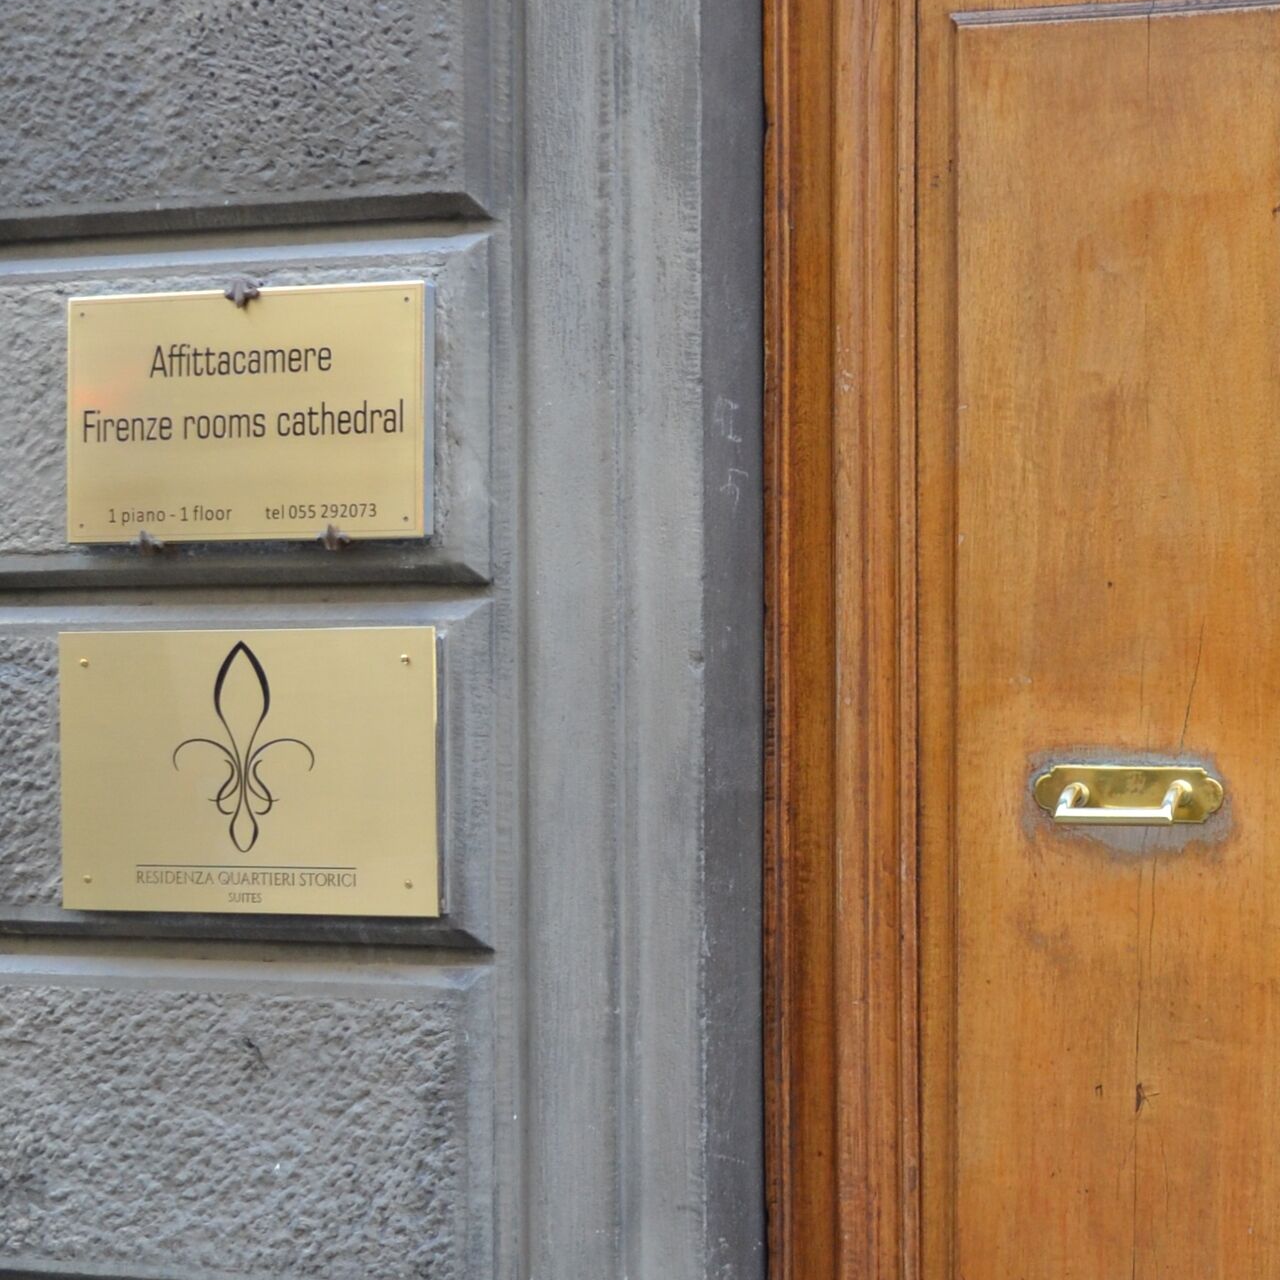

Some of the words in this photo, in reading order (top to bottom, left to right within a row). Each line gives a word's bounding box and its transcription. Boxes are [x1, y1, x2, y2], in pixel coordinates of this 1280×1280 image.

[149, 344, 332, 378] Affittacamere
[82, 409, 173, 443] Firenze
[183, 413, 266, 440] rooms
[276, 398, 405, 436] cathedral
[108, 508, 117, 523] 1
[121, 508, 166, 528] piano
[180, 506, 188, 522] 1
[193, 505, 232, 522] floor
[265, 504, 285, 520] tel
[288, 504, 317, 520] 055
[320, 503, 378, 519] 292073
[136, 870, 215, 887] RESIDENZA
[217, 871, 296, 888] QUARTIERI
[299, 872, 357, 888] STORICI
[228, 891, 262, 904] SUITES
